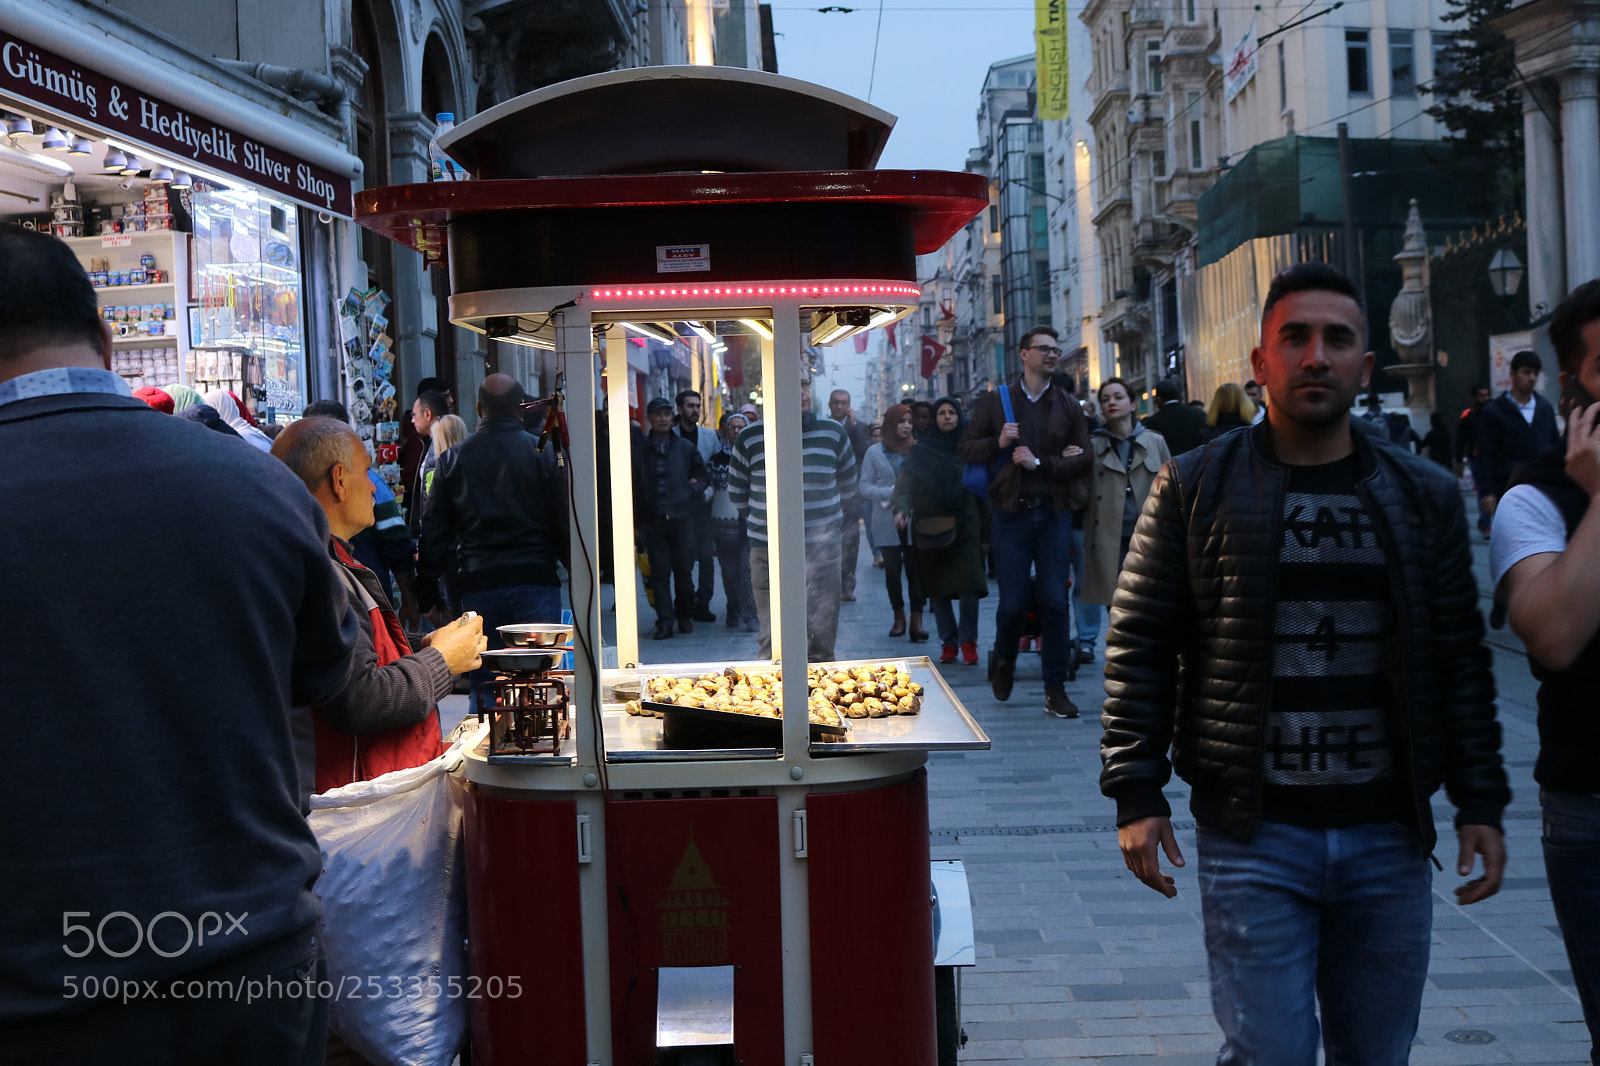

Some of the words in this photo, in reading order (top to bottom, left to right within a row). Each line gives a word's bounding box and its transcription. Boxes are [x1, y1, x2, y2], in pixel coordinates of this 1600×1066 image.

[1049, 39, 1062, 112] ENGLISH
[2, 41, 98, 118] Gümüş
[108, 85, 129, 121] &
[139, 97, 238, 163] Hediyelik
[243, 141, 291, 184] Silver
[296, 163, 335, 209] Shop
[1307, 614, 1341, 662] 4
[1272, 724, 1374, 771] LIFE
